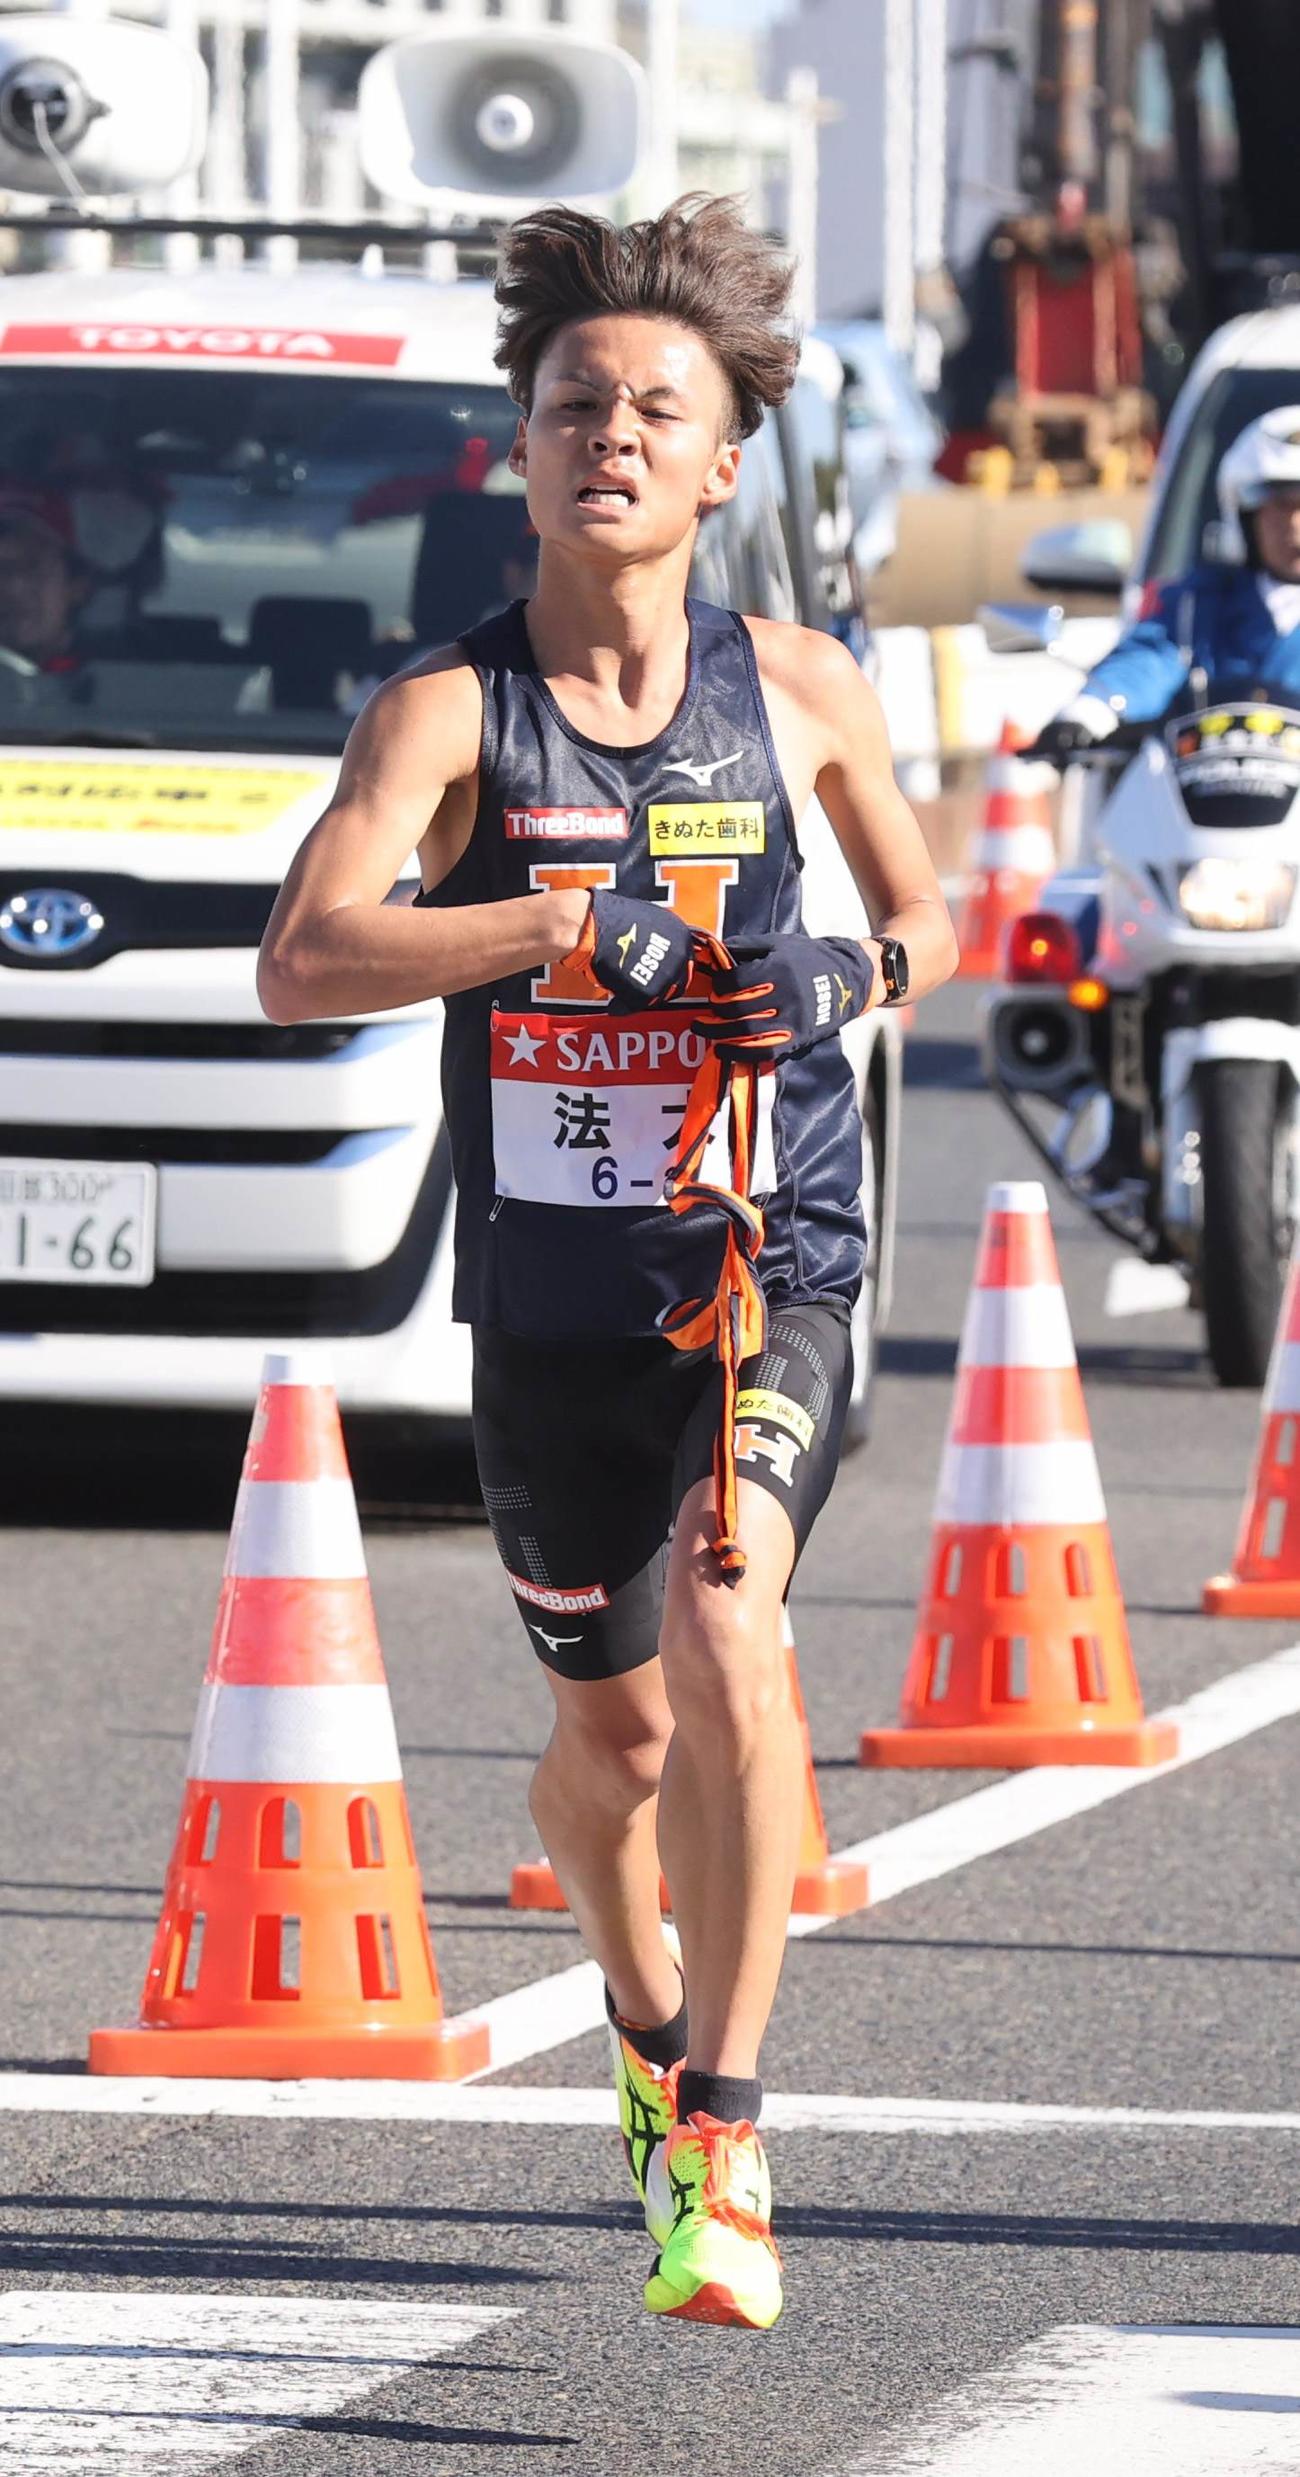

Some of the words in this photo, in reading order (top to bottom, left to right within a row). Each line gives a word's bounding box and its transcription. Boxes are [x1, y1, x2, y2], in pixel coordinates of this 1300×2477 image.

[71, 327, 336, 357] TOYOTA
[508, 812, 625, 837] ThreeBond
[654, 816, 760, 841] きぬた歯科
[629, 932, 672, 987] HOSEI
[813, 973, 833, 1027] HOSEI
[556, 1029, 707, 1073] SAPPO
[591, 1156, 678, 1200] 6-
